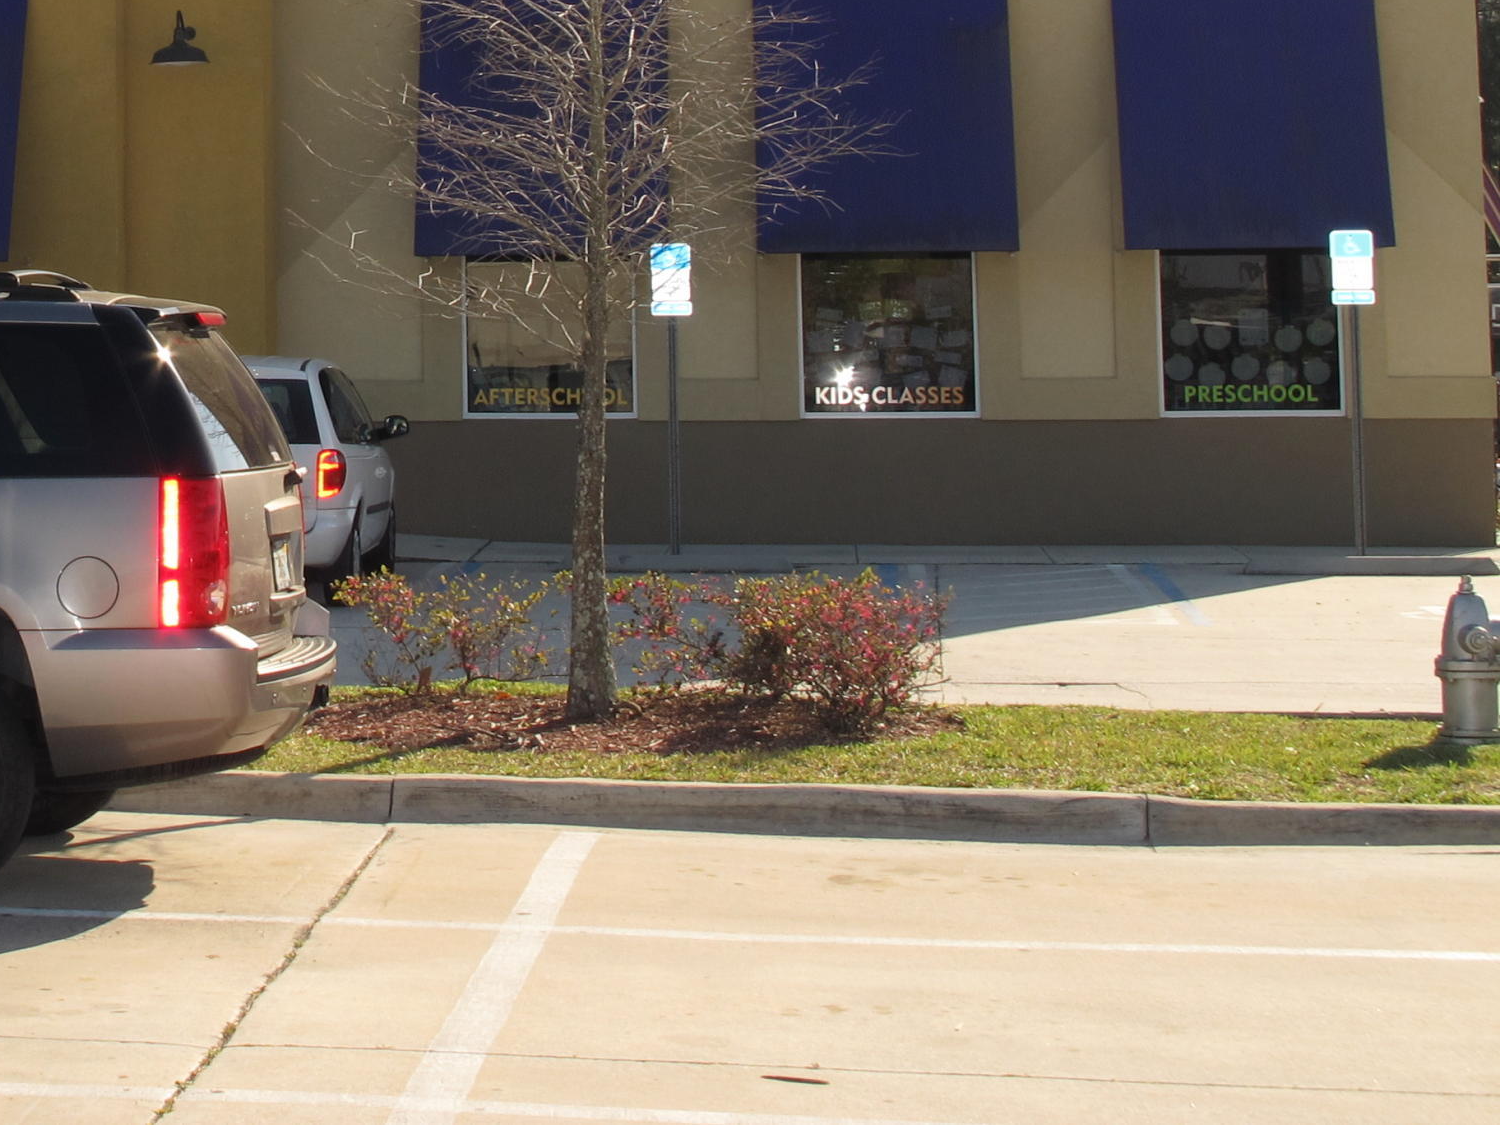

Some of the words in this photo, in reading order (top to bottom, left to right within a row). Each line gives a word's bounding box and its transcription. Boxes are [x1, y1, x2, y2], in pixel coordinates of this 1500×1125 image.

[474, 388, 628, 405] AFTERSCHOL
[815, 386, 867, 405] KIDS
[871, 386, 964, 405] CLASSES
[1184, 384, 1319, 403] PRESCHOOL
